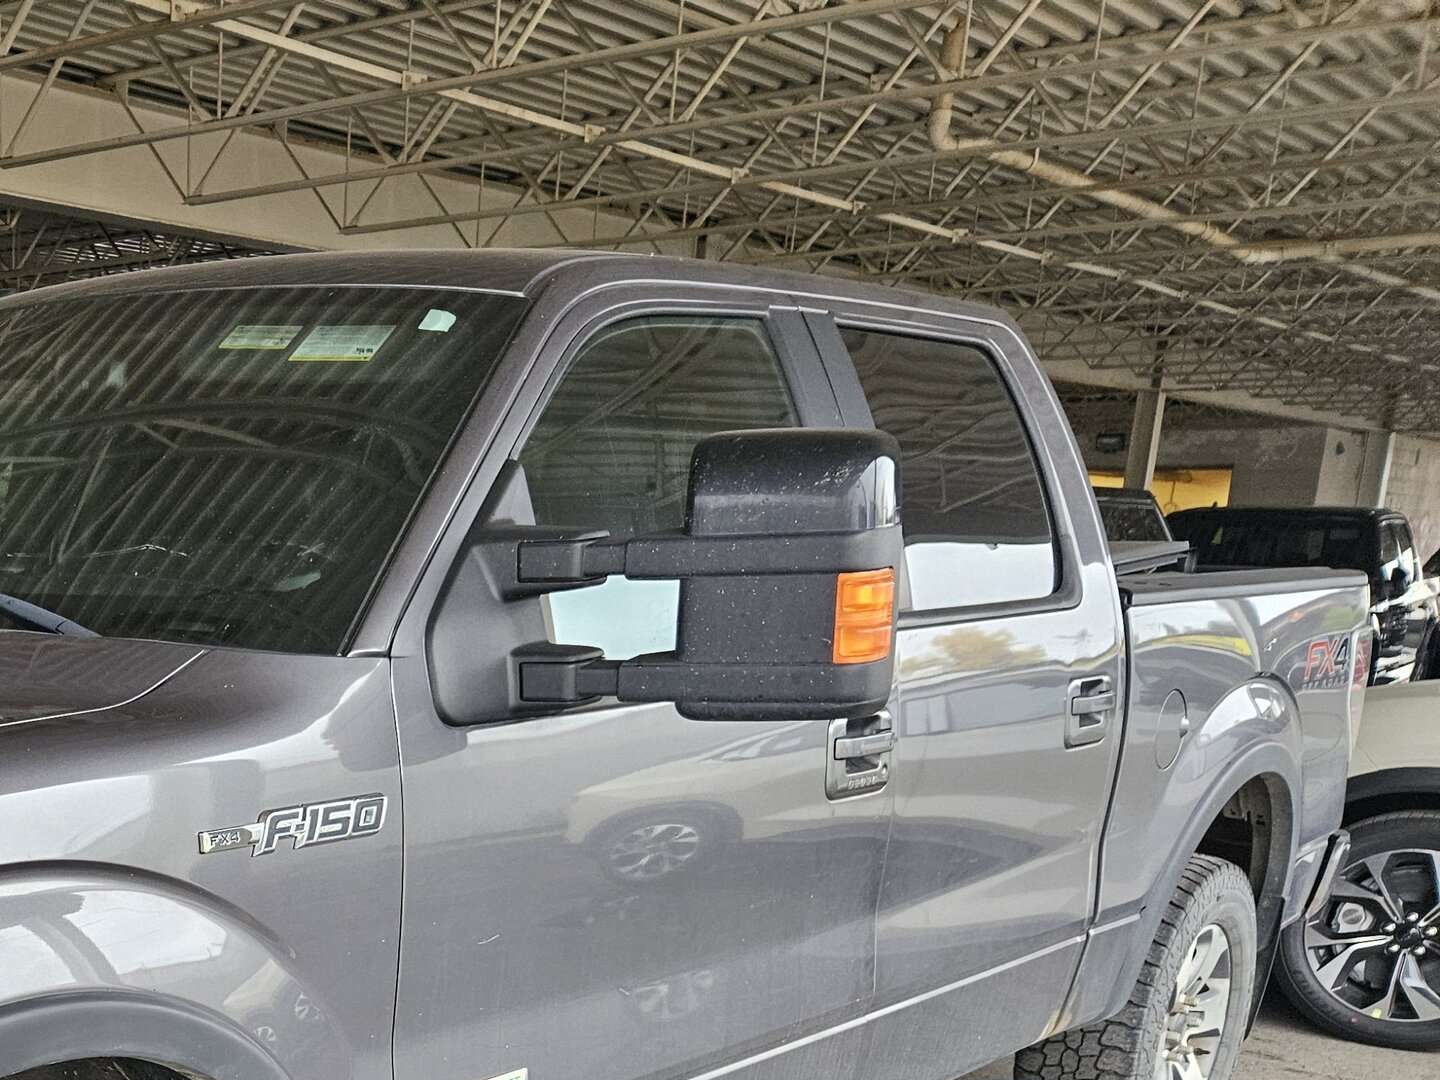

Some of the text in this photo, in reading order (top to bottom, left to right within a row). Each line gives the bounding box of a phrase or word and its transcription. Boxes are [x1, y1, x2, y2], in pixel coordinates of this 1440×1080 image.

[1304, 635, 1350, 681] FX4
[209, 797, 388, 857] FX4 F-150
